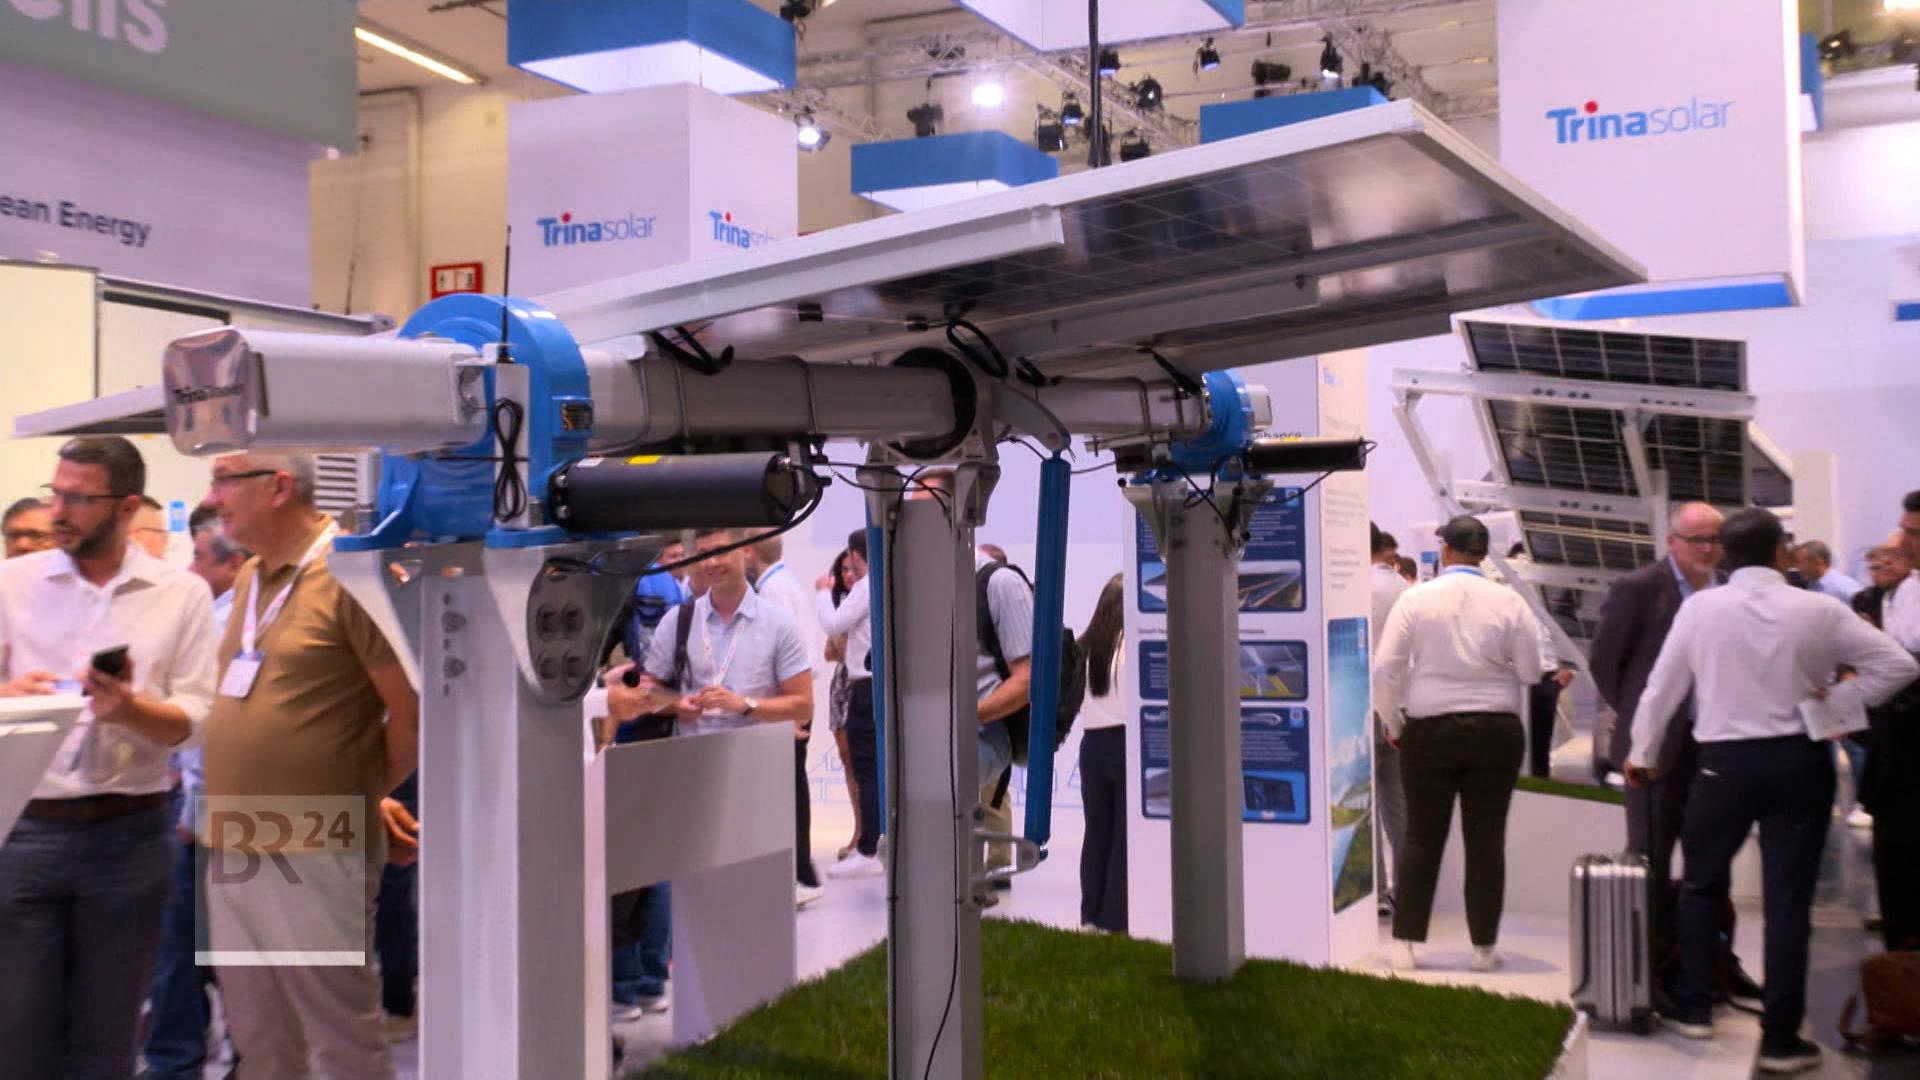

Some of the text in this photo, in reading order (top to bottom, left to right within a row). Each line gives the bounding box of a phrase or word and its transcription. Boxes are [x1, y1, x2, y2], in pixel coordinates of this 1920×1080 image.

[1545, 96, 1736, 144] Trinasolar
[0, 195, 152, 248] ean Energy
[536, 211, 656, 247] Trinasolar
